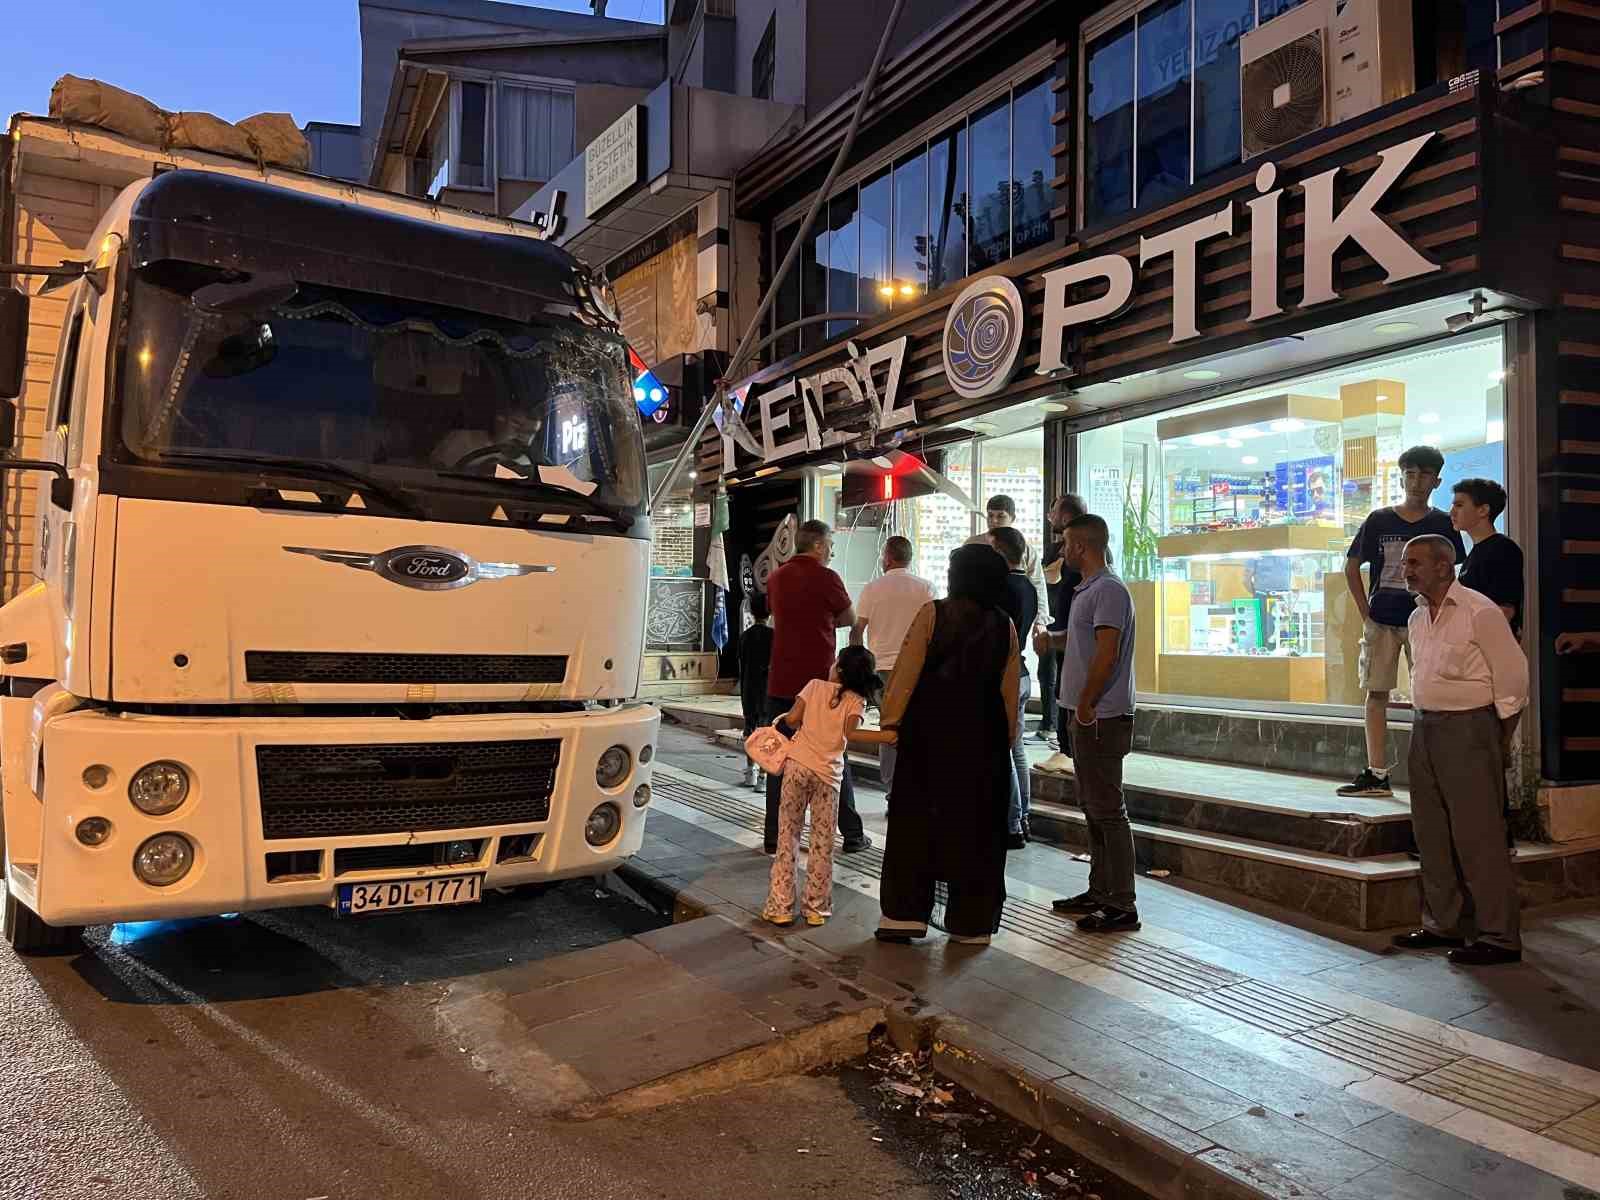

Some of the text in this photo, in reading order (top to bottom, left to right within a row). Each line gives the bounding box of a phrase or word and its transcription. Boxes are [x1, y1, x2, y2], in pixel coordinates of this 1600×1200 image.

[406, 556, 451, 577] Ford
[341, 877, 476, 909] TR 34 DL 1771
